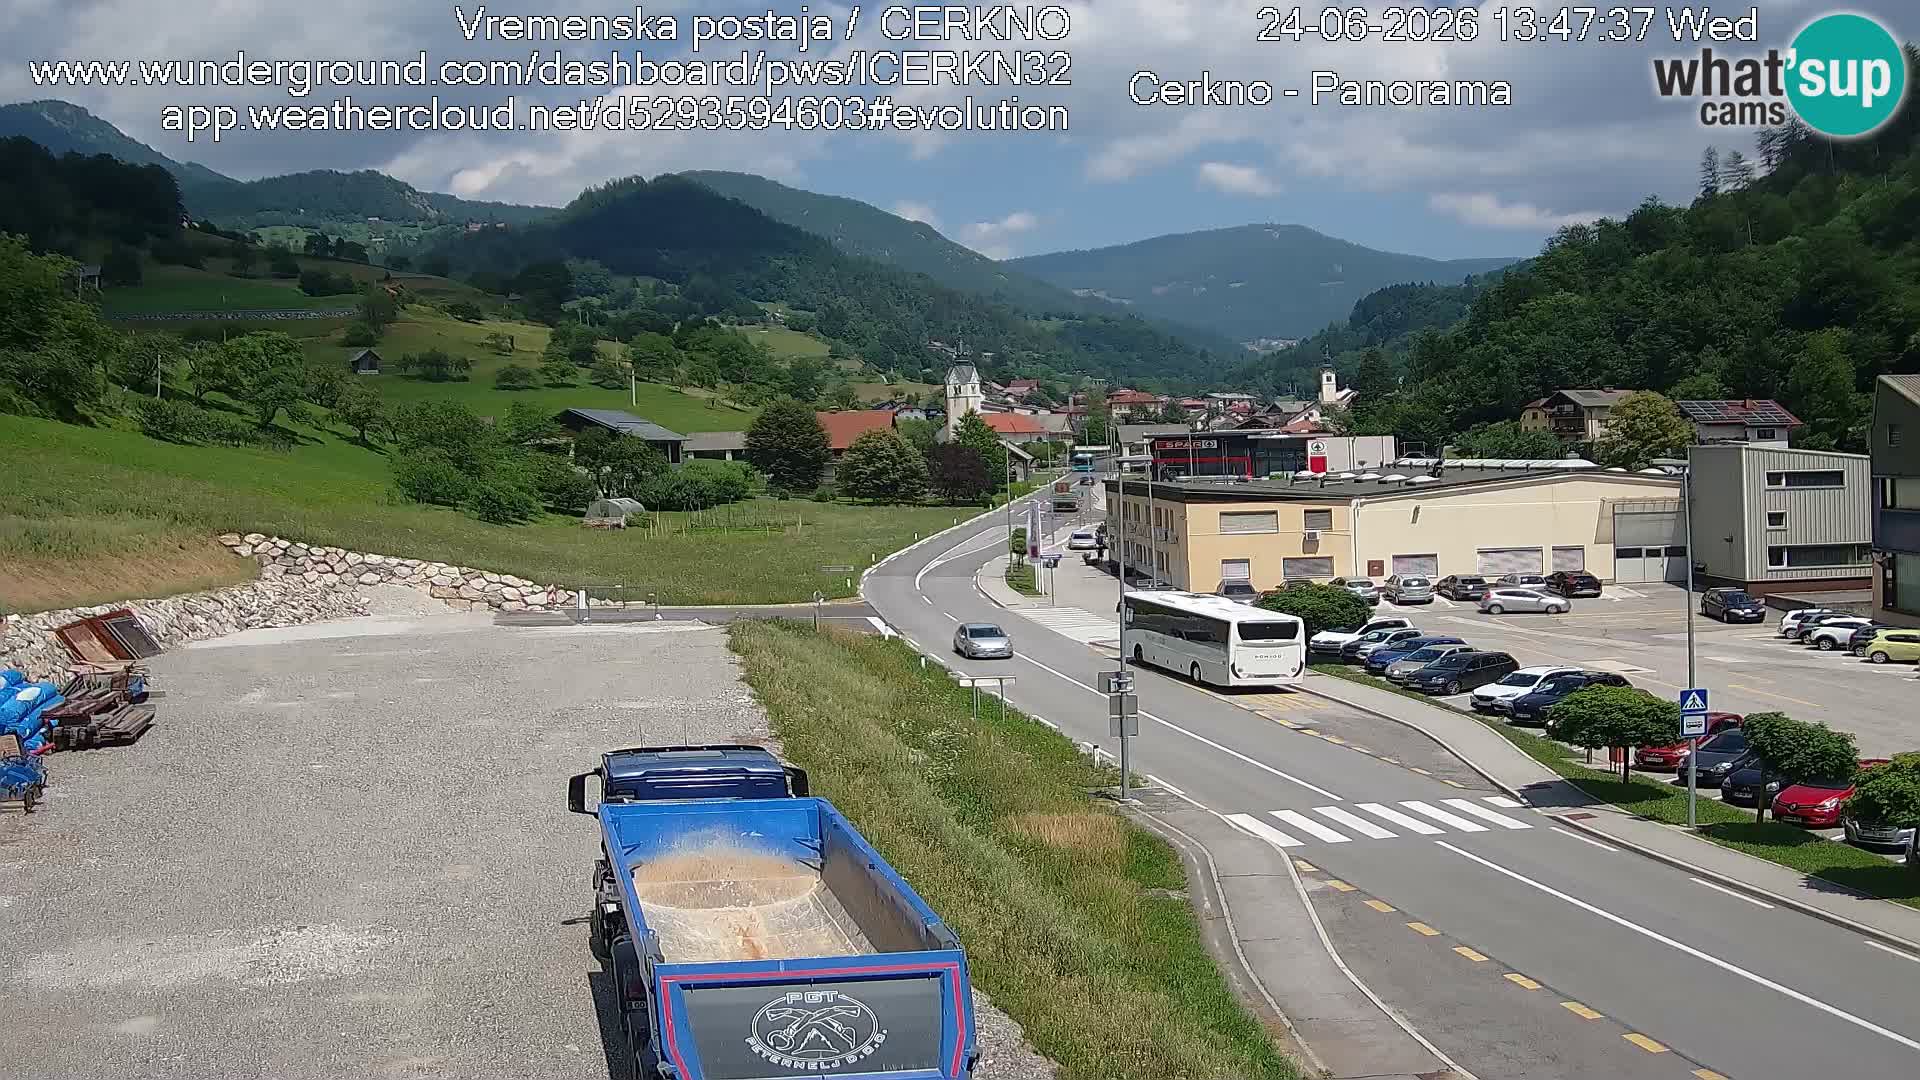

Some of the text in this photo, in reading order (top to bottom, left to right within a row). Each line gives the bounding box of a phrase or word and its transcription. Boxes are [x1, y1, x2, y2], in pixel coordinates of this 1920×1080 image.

[1166, 441, 1202, 449] SPAR
[786, 990, 839, 1005] PGT
[745, 1036, 841, 1070] PETERNELJ
